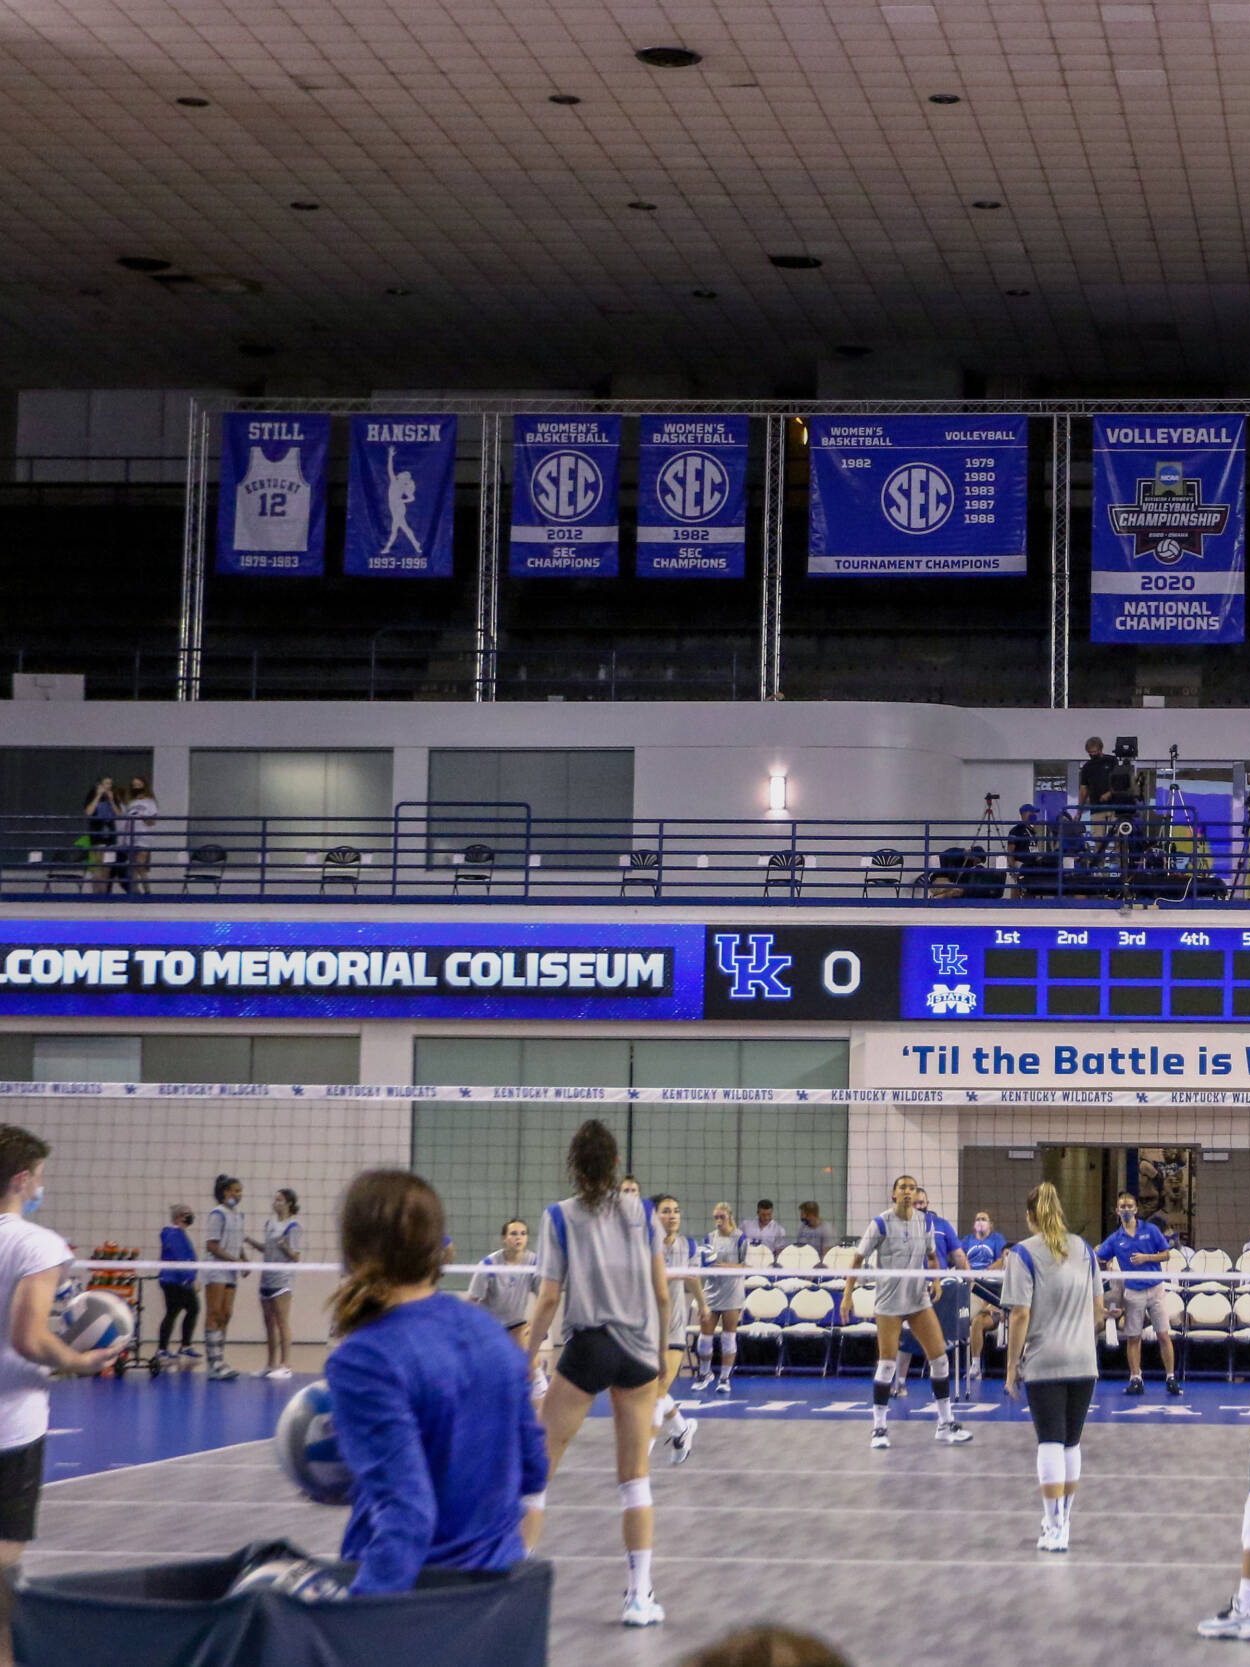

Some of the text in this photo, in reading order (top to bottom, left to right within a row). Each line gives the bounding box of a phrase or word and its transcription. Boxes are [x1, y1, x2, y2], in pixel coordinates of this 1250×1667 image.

[249, 423, 304, 440] STILL
[367, 425, 440, 441] HANSEN
[538, 424, 597, 432] WOMEN'S
[664, 424, 724, 433] WOMEN'S
[831, 427, 882, 435] WOMEN'S
[527, 433, 608, 442] BASKETBALL
[653, 434, 735, 443] BASKETBALL
[946, 431, 1015, 440] VOLLEYBALL
[1107, 428, 1231, 443] VOLLEYBALL
[822, 437, 892, 445] BASKETBALL
[842, 459, 871, 468] 1982
[966, 459, 994, 467] 1979
[965, 473, 995, 481] 1980
[244, 479, 300, 494] KENTUCKY
[538, 456, 595, 516] SEC
[664, 456, 721, 516] SEC
[965, 487, 994, 495] 1983
[889, 469, 947, 529] SEC
[259, 493, 286, 516] 12
[966, 500, 994, 509] 1987
[1142, 503, 1196, 512] VOLLEYBALL
[965, 514, 994, 523] 1988
[1119, 513, 1220, 526] CHAMPIONSHIP
[548, 529, 582, 540] 2012
[674, 530, 709, 540] 1982
[553, 548, 575, 557] SEC
[680, 548, 701, 557] SEC
[527, 558, 600, 567] CHAMPIONS
[654, 559, 726, 568] CHAMPIONS
[835, 559, 999, 569] TOURNAMENT CHAMPIONS
[1141, 576, 1195, 590] 2020
[1125, 602, 1211, 615] NATIONAL
[1116, 617, 1220, 630] CHAMPIONS
[996, 930, 1020, 943] 1st
[1058, 931, 1087, 944] 2nd
[1119, 932, 1145, 945] 3rd
[1180, 932, 1209, 945] 4th
[0, 949, 664, 987] COME TO MEMORIAL COLISEUM
[824, 951, 860, 993] 0
[935, 994, 968, 1003] STATE
[973, 1046, 1039, 1074] the
[1055, 1046, 1184, 1074] Battle
[1199, 1047, 1231, 1075] is
[663, 1089, 774, 1100] KENTUCKY WILDCATS
[832, 1089, 943, 1101] KENTUCKY WILDCATS
[1001, 1091, 1113, 1103] KENTUCKY WILDCATS
[1171, 1092, 1226, 1104] KENTUCKY
